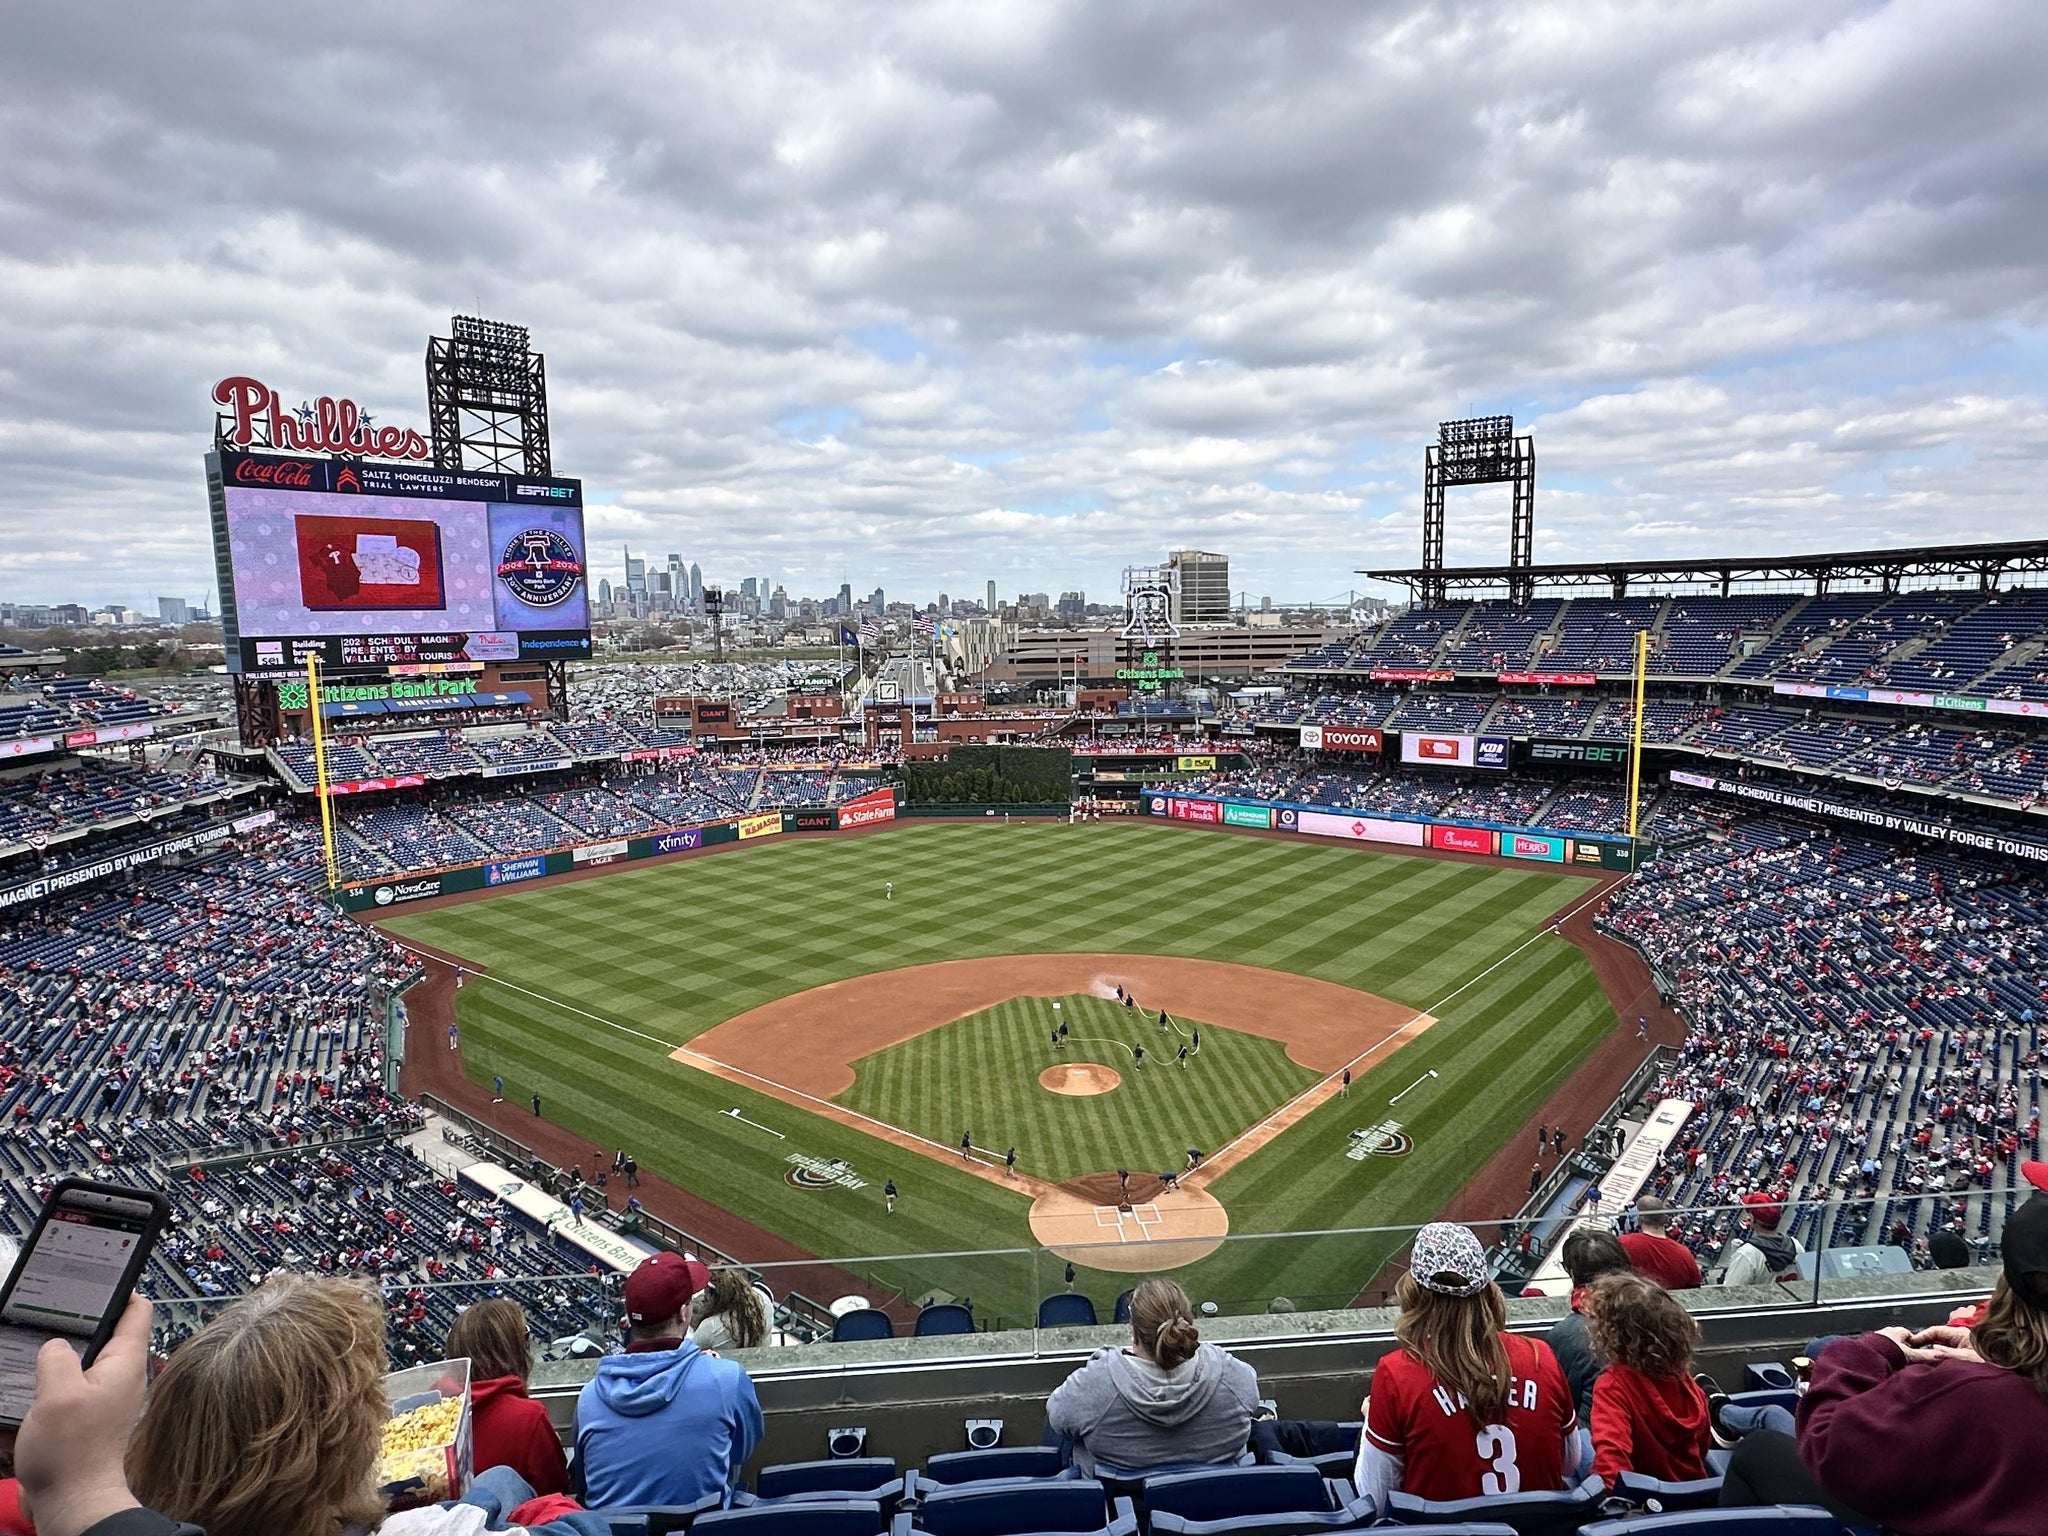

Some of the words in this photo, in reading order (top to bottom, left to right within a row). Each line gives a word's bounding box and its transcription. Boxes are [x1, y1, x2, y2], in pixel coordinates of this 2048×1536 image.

[212, 376, 429, 460] Phillies
[235, 458, 314, 486] Coca-Cola
[361, 470, 391, 480] SALTZ
[395, 472, 454, 484] MONGELUZZI
[456, 477, 500, 488] BENDESKY
[363, 481, 393, 489] TRIAL
[400, 483, 444, 493] LAWYERS
[556, 561, 580, 570] 2024
[521, 575, 573, 602] ANNIVERSARY
[292, 640, 326, 649] Building
[343, 638, 365, 646] 2024
[368, 636, 419, 645] SCHEDULE
[421, 635, 459, 644] MAGNET
[522, 639, 579, 649] Independence
[344, 645, 401, 655] PRESENTED
[404, 645, 417, 653] BY
[345, 654, 381, 663] VALLEY
[384, 653, 416, 662] FORGE
[419, 652, 460, 661] TOURISM
[1116, 668, 1157, 679] Citizens
[1159, 668, 1184, 679] Bank
[391, 679, 436, 698] Bank
[438, 677, 477, 696] Park
[1138, 679, 1162, 690] Park
[1945, 696, 1983, 710] Citizens
[1324, 732, 1378, 747] TOYOTA
[496, 765, 529, 775] LISCIO'S
[530, 761, 559, 773] BAKERY
[1189, 801, 1216, 814] Temple
[797, 817, 831, 826] GIANT
[1189, 811, 1214, 821] Health
[1718, 782, 1736, 793] 2024
[1737, 785, 1782, 804] SCHEDULE
[1783, 794, 1823, 814] MAGNET
[1823, 804, 1883, 826] PRESENTED
[1886, 815, 1902, 829] BY
[1903, 820, 1947, 840] VALLEY
[1949, 829, 1993, 849] FORGE
[658, 834, 697, 851] xfinity
[1517, 840, 1547, 854] HERR'S
[0, 880, 49, 908] MAGNET
[51, 861, 113, 891] PRESENTED
[114, 857, 128, 874] BY
[129, 845, 163, 866] VALLEY
[165, 835, 194, 855] FORGE
[193, 825, 230, 845] TOURISM
[501, 859, 539, 872] SHERWIN
[590, 856, 613, 865] LAGER
[501, 868, 540, 881] WILLIAMS
[394, 880, 441, 896] NovaCare
[1378, 1119, 1404, 1135] DAY
[1346, 1130, 1391, 1160] OPENING
[784, 1152, 844, 1179] OPENING
[835, 1174, 869, 1190] DAY
[563, 1219, 613, 1251] Citizens
[608, 1245, 643, 1269] Bank
[1432, 1374, 1538, 1417] HAER
[1476, 1424, 1520, 1496] 3
